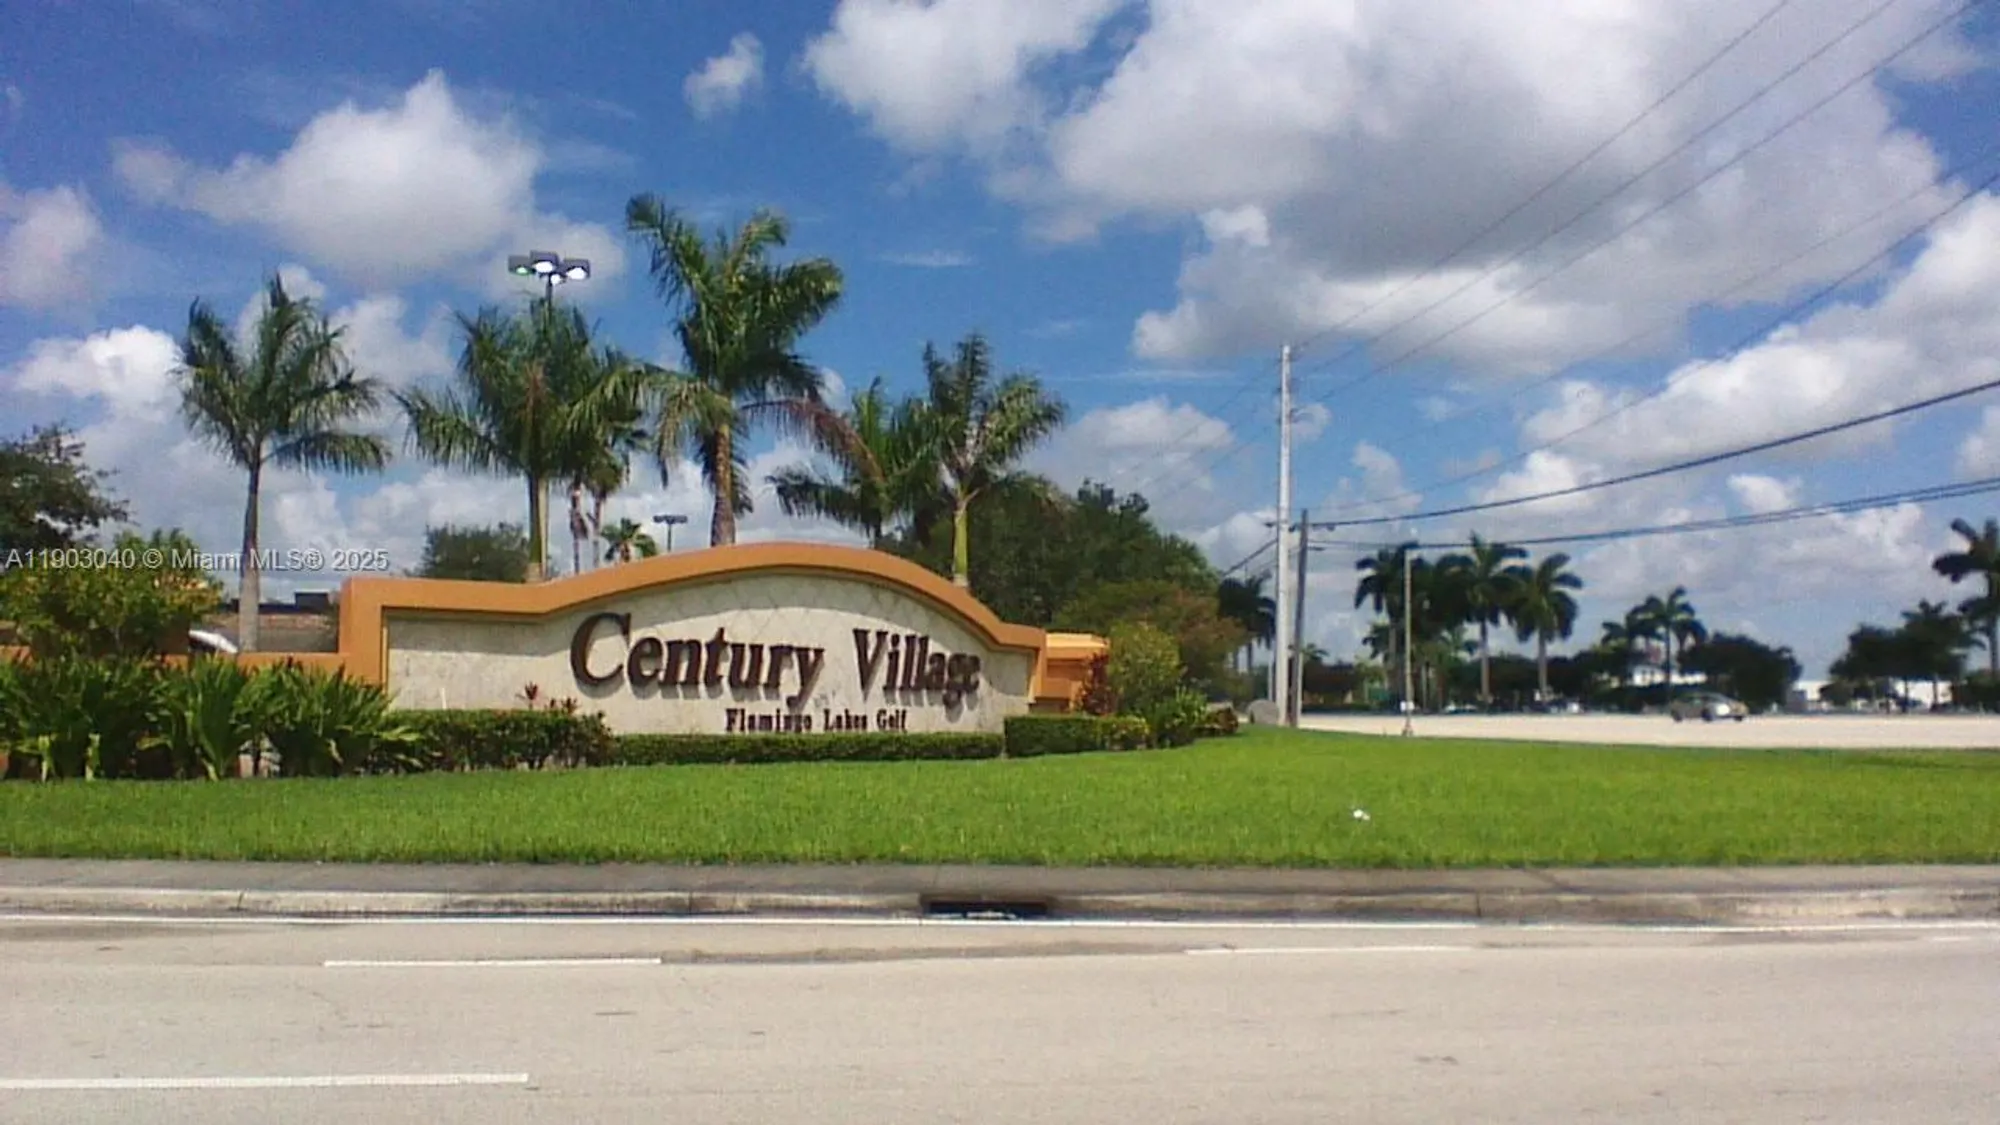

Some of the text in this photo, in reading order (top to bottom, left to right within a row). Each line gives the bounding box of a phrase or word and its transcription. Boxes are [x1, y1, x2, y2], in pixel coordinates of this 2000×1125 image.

[570, 612, 981, 709] Century Village
[726, 708, 907, 732] Flamingo Lakes Golf
